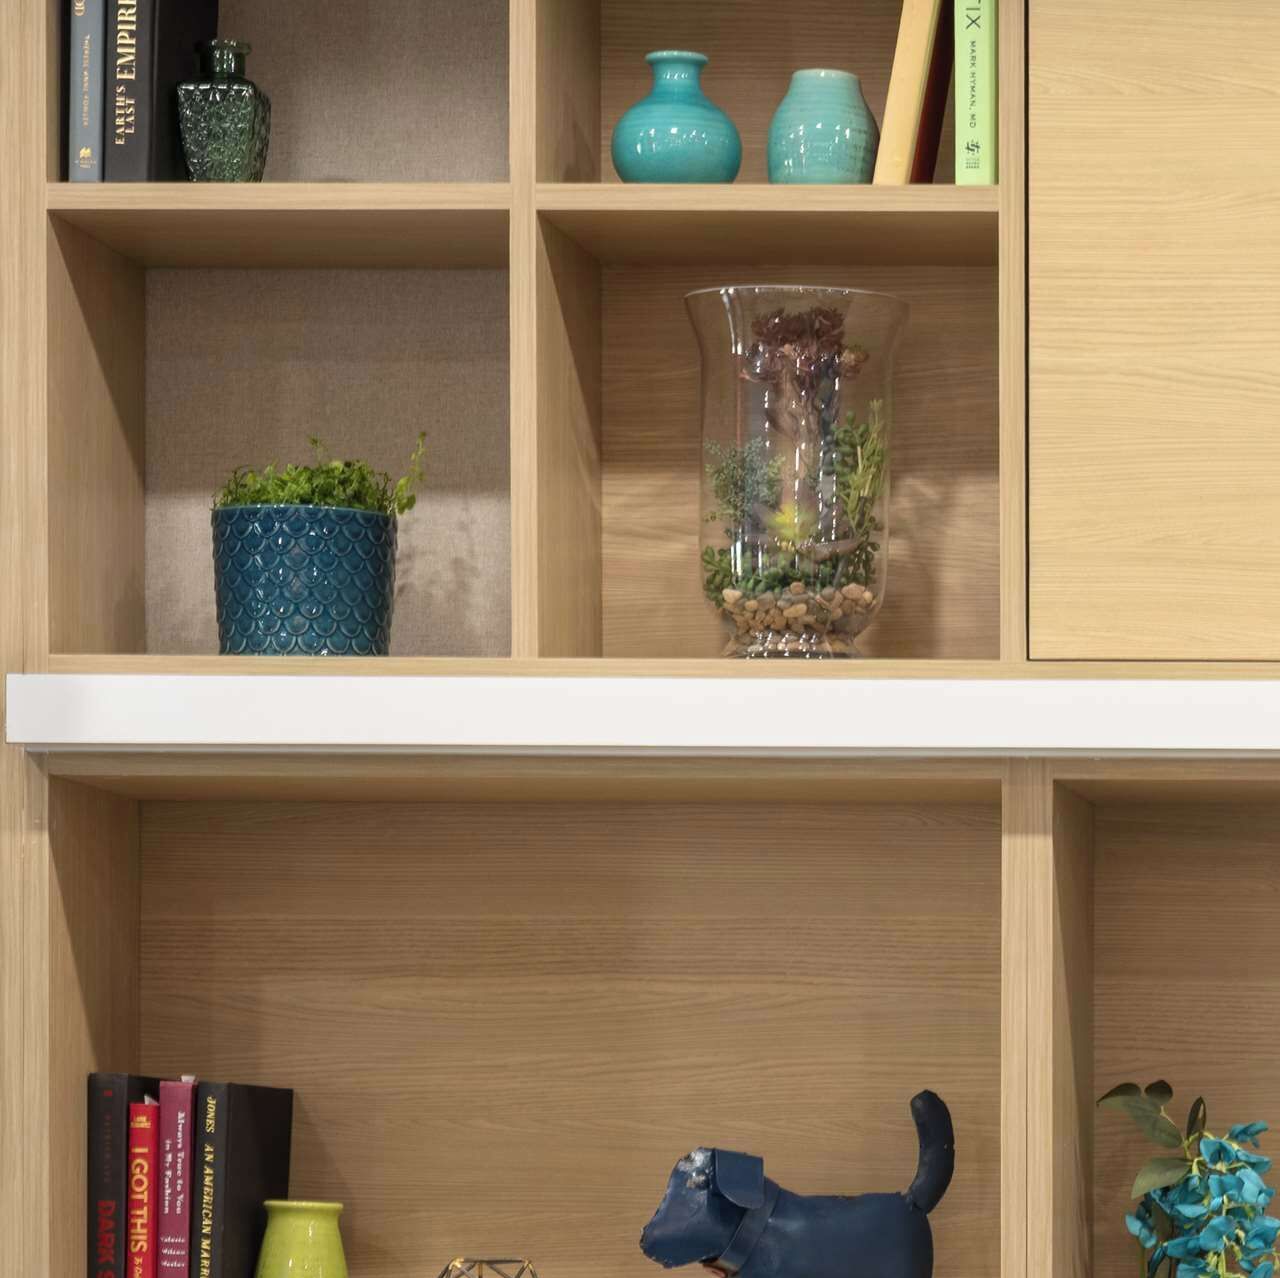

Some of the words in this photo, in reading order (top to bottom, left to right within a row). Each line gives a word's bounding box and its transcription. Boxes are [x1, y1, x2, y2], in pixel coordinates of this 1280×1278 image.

[969, 40, 977, 68] MARK
[968, 71, 978, 111] HYMAN,
[114, 85, 126, 146] EARTH'S
[125, 98, 136, 134] LAST
[969, 113, 977, 129] MD
[205, 1096, 217, 1134] JONES
[204, 1143, 215, 1163] AN
[131, 1158, 149, 1204] GOT
[201, 1165, 214, 1235] AMERICAN
[96, 1199, 116, 1264] DARK
[130, 1206, 148, 1254] THIS
